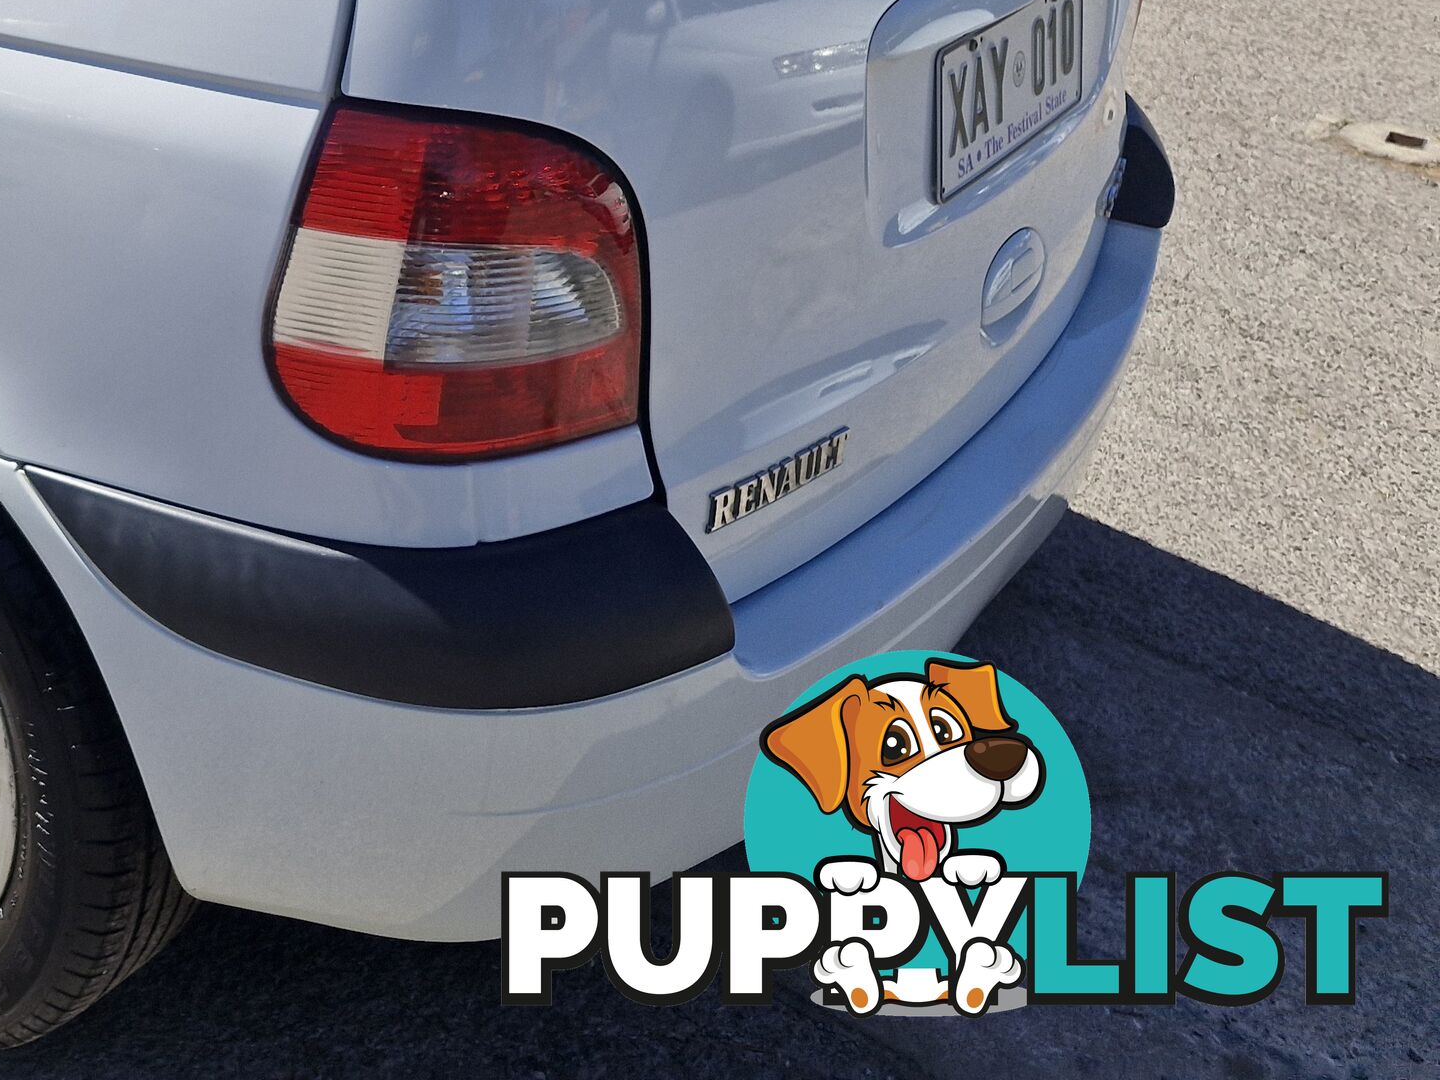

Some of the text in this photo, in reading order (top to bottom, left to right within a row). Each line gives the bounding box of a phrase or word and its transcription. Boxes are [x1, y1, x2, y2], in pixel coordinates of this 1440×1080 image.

[948, 35, 1009, 159] XAY
[958, 89, 1067, 179] SA The Festival State
[706, 425, 850, 534] RENAULT
